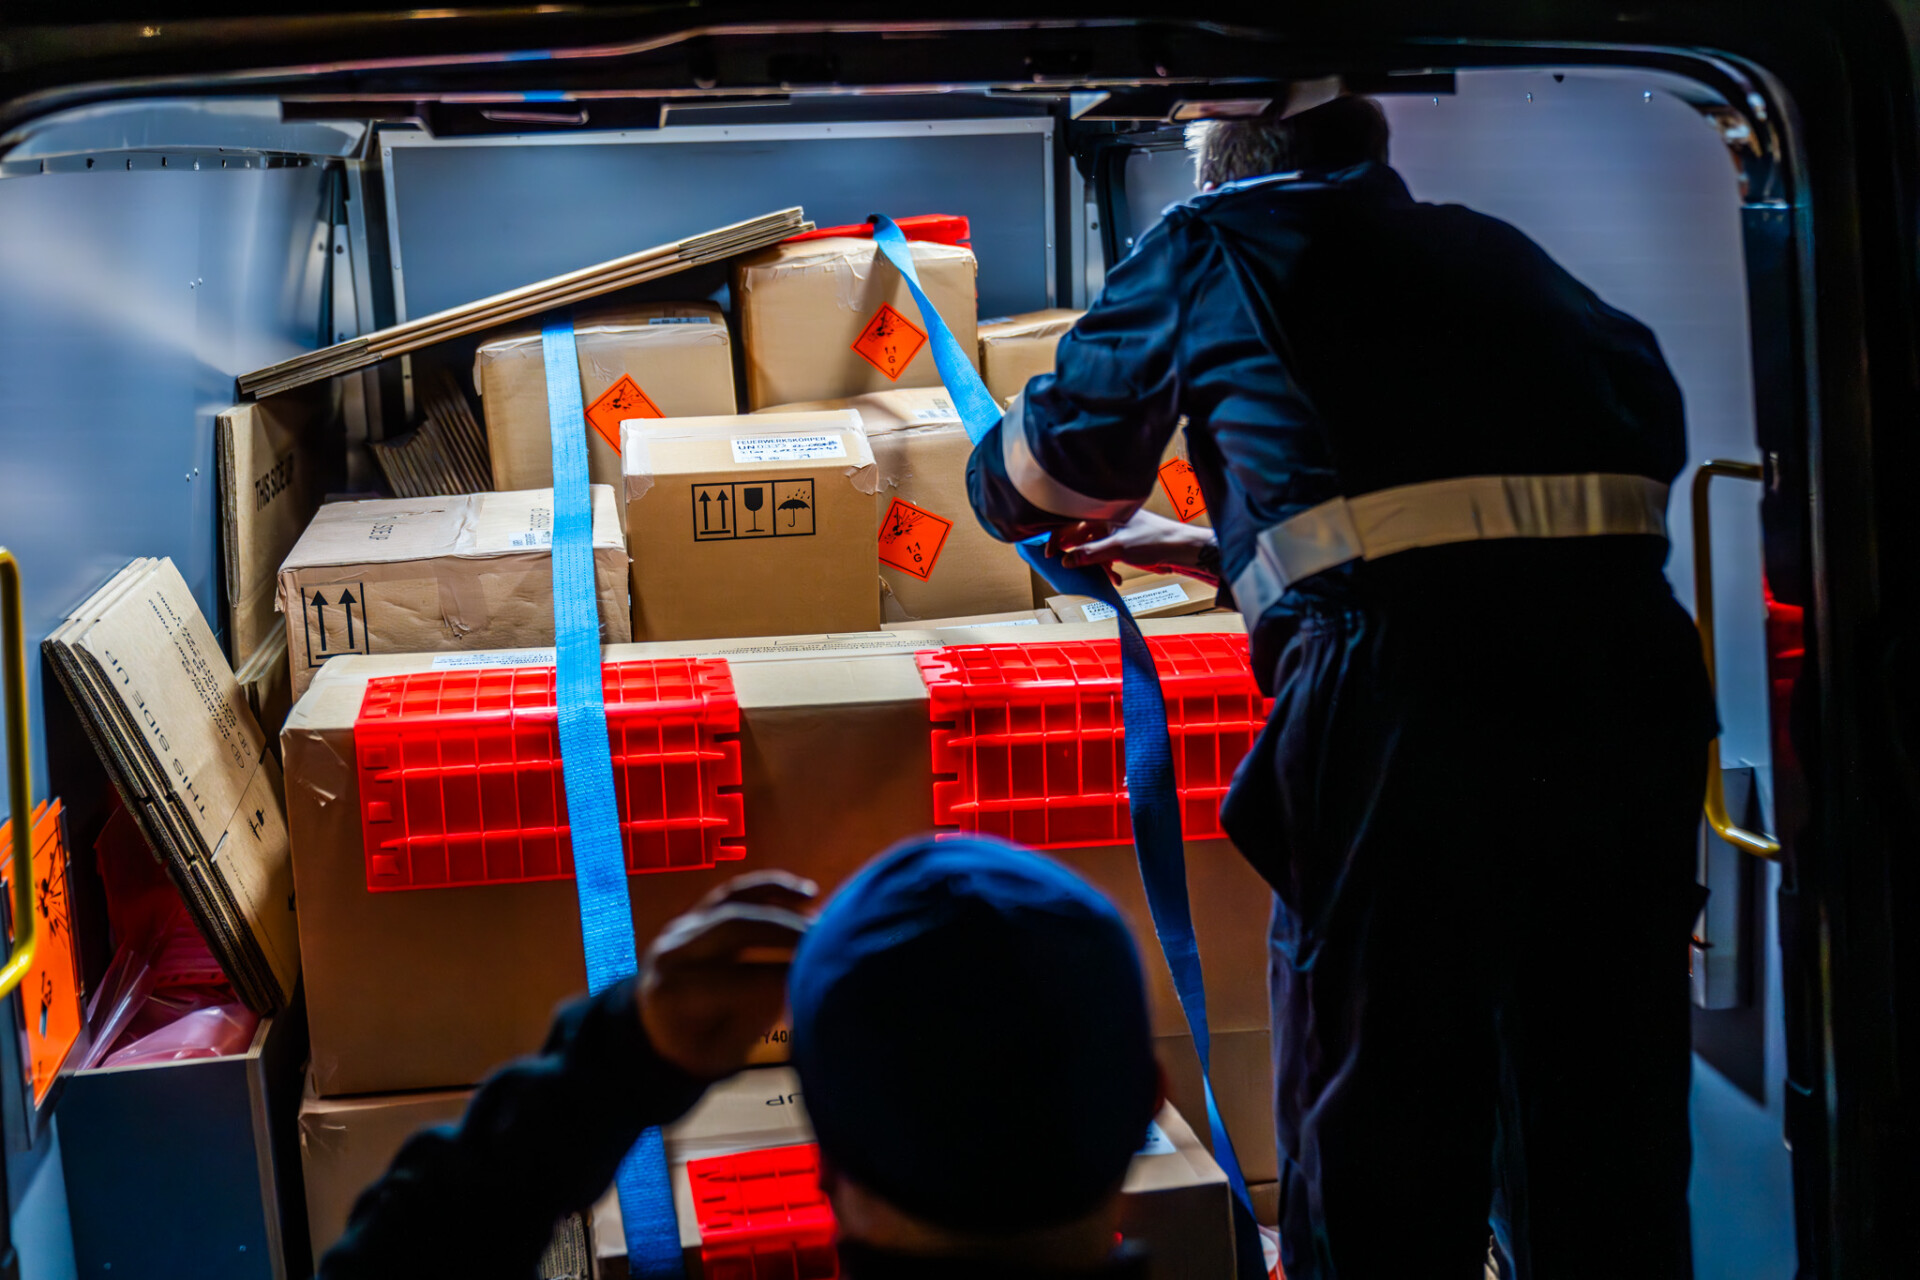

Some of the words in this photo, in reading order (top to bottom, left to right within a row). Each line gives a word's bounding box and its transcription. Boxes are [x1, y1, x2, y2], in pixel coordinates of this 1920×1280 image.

[887, 355, 896, 364] G
[1187, 485, 1200, 496] 1.1
[1186, 496, 1195, 505] G
[906, 542, 921, 554] 1.1
[913, 553, 923, 563] G
[104, 649, 131, 686] UP
[132, 689, 171, 752] SIDE
[172, 757, 206, 820] THIS
